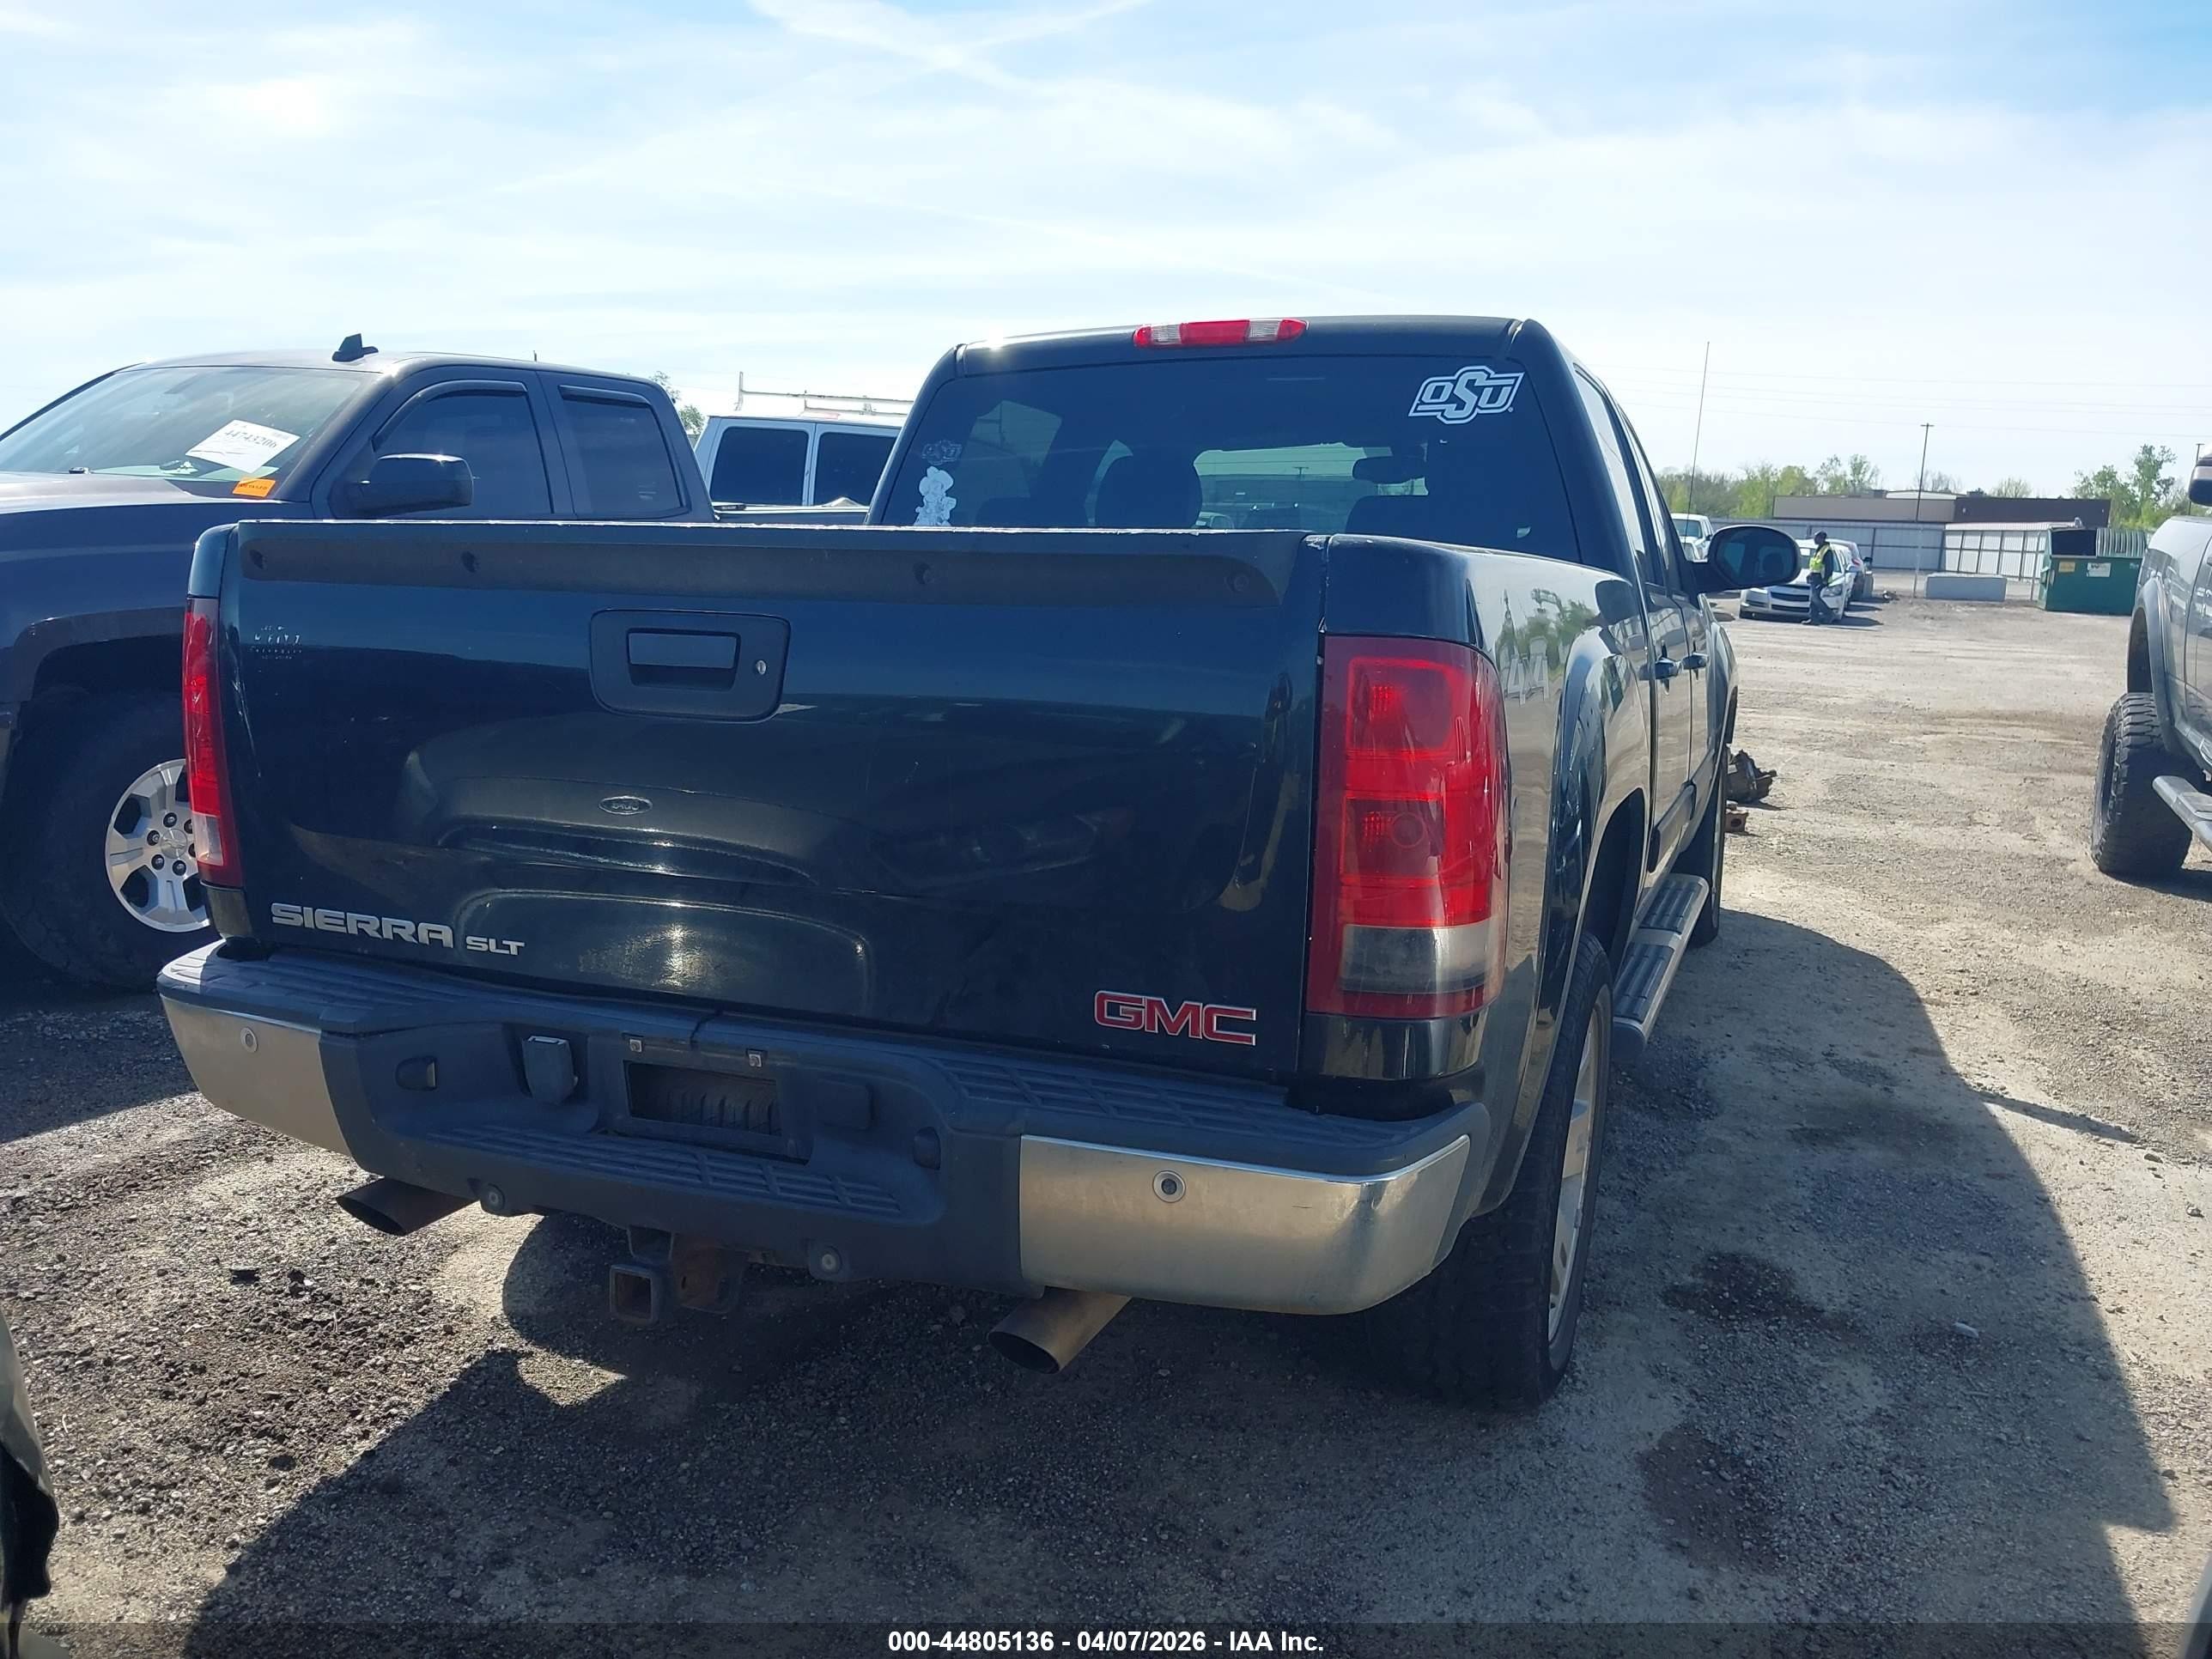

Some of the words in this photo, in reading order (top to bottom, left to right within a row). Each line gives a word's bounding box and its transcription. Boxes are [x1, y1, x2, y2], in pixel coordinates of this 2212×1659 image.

[1415, 370, 1517, 420] OSU
[270, 902, 454, 949] SIERRA
[465, 935, 526, 956] SLT
[1094, 989, 1257, 1047] GMC
